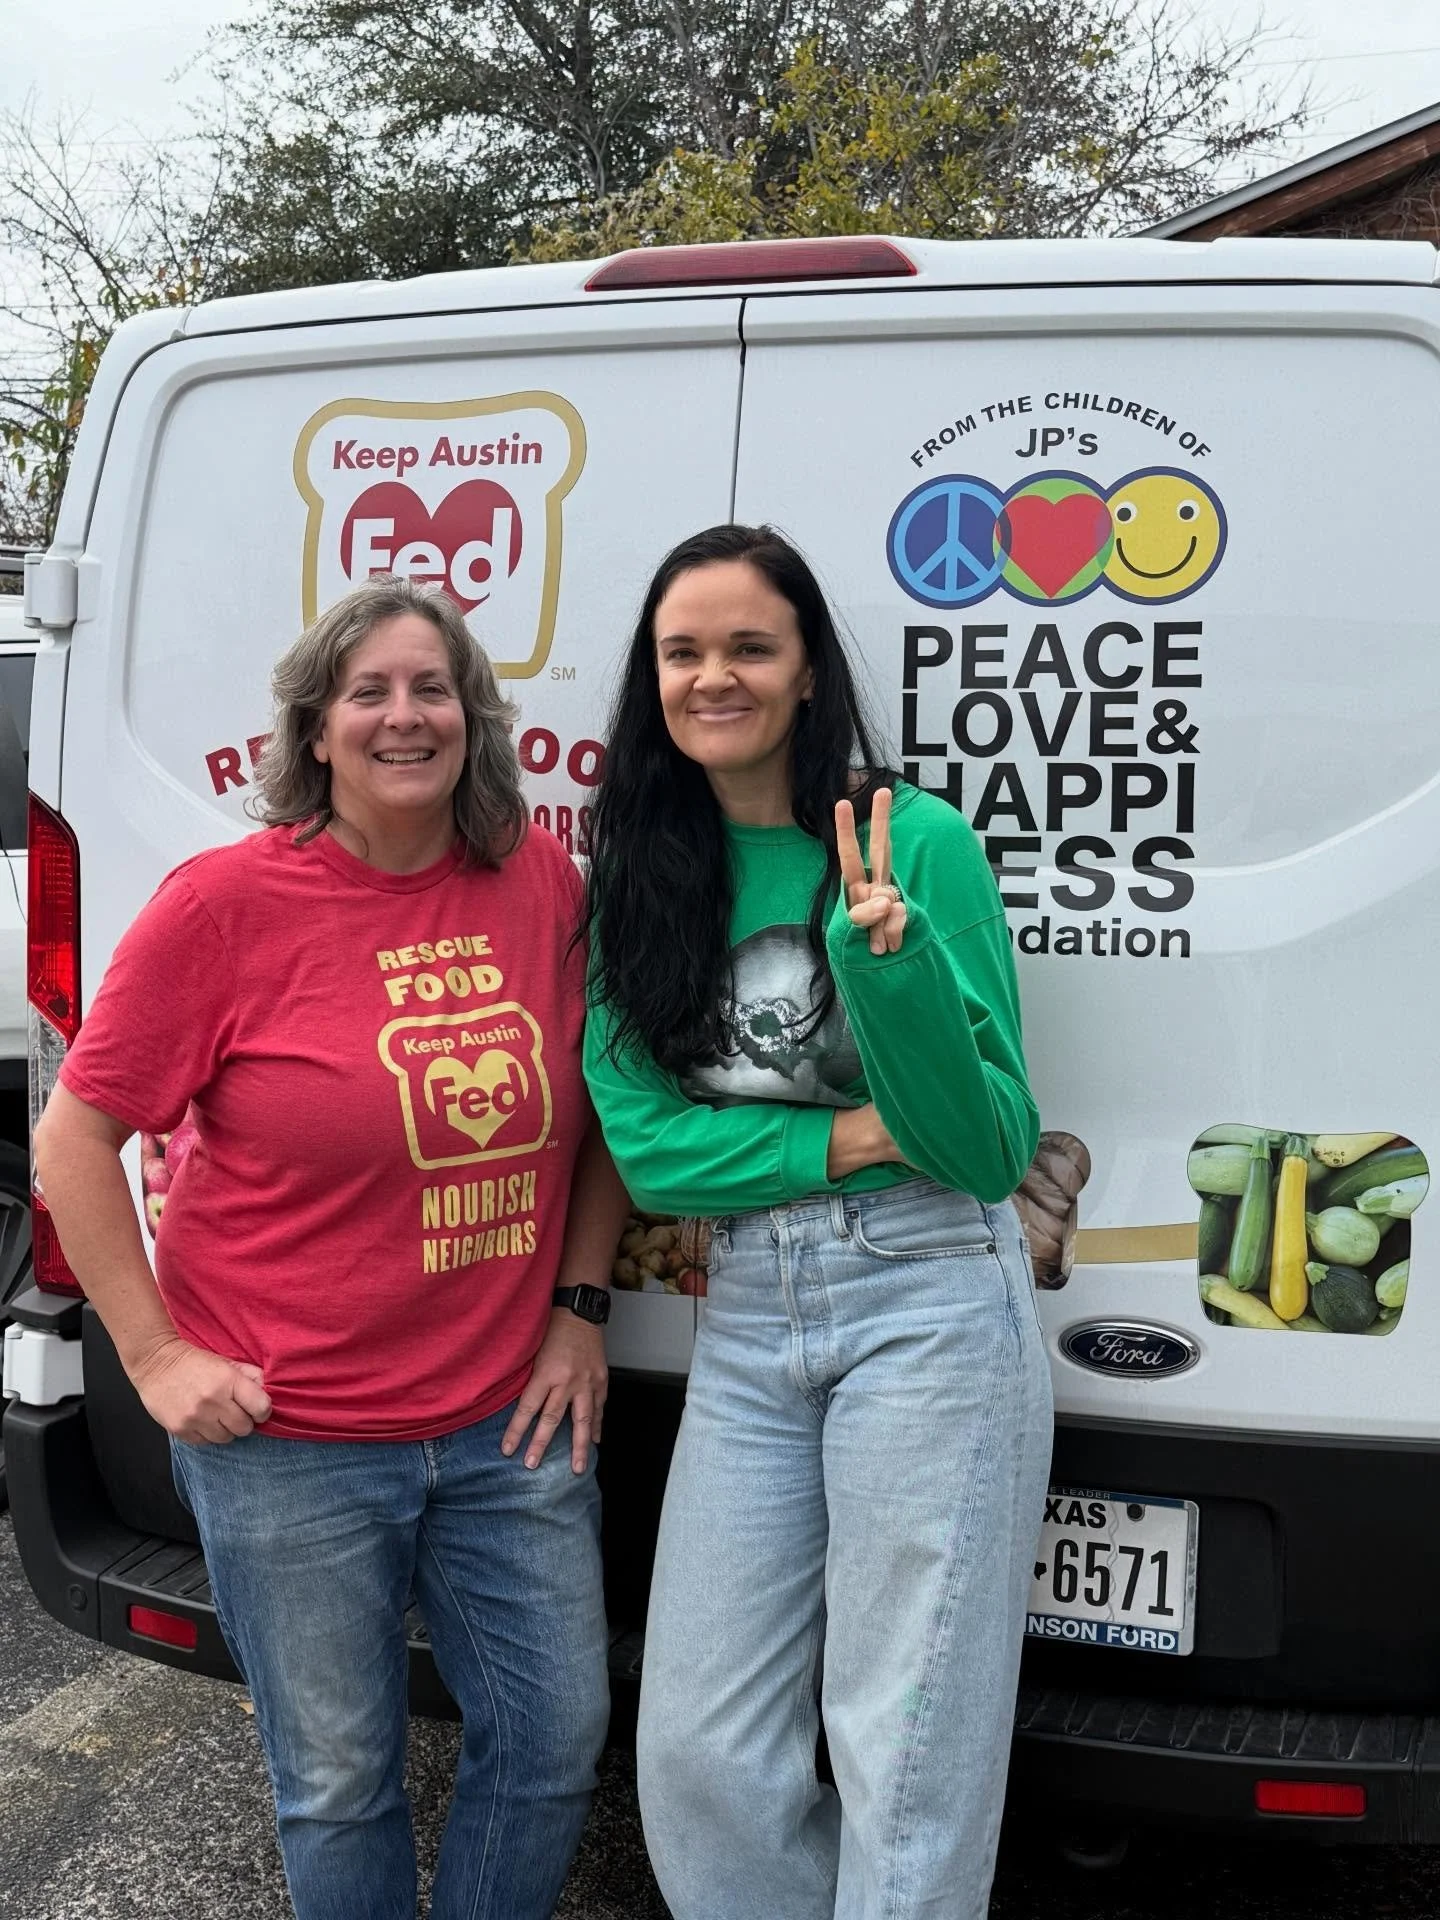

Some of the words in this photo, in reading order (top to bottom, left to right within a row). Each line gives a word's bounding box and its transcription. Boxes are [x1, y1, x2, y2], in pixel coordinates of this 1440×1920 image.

[910, 415, 978, 468] FROM
[981, 396, 1033, 423] THE
[1044, 392, 1177, 435] CHILDREN
[1178, 431, 1212, 459] OF
[1015, 427, 1099, 457] JP'S
[333, 440, 419, 477] Keep
[429, 433, 543, 467] Austin
[350, 508, 513, 601] Fed
[551, 667, 576, 681] SM
[902, 621, 1203, 689] PEACE
[984, 835, 1196, 912] ESS
[377, 935, 493, 972] RESCUE
[1008, 916, 1191, 958] dation
[384, 965, 503, 1006] FOOD
[403, 1035, 455, 1055] Keep
[460, 1025, 522, 1048] Austin
[429, 1062, 527, 1120] Fed
[423, 1171, 537, 1230] NOURISH
[423, 1221, 537, 1274] NEIGHBORS
[1089, 1333, 1165, 1367] Ford
[1043, 1497, 1107, 1529] XAS
[1053, 1538, 1174, 1617] 6571
[1028, 1615, 1098, 1641] NSON
[1106, 1625, 1176, 1650] FORD
